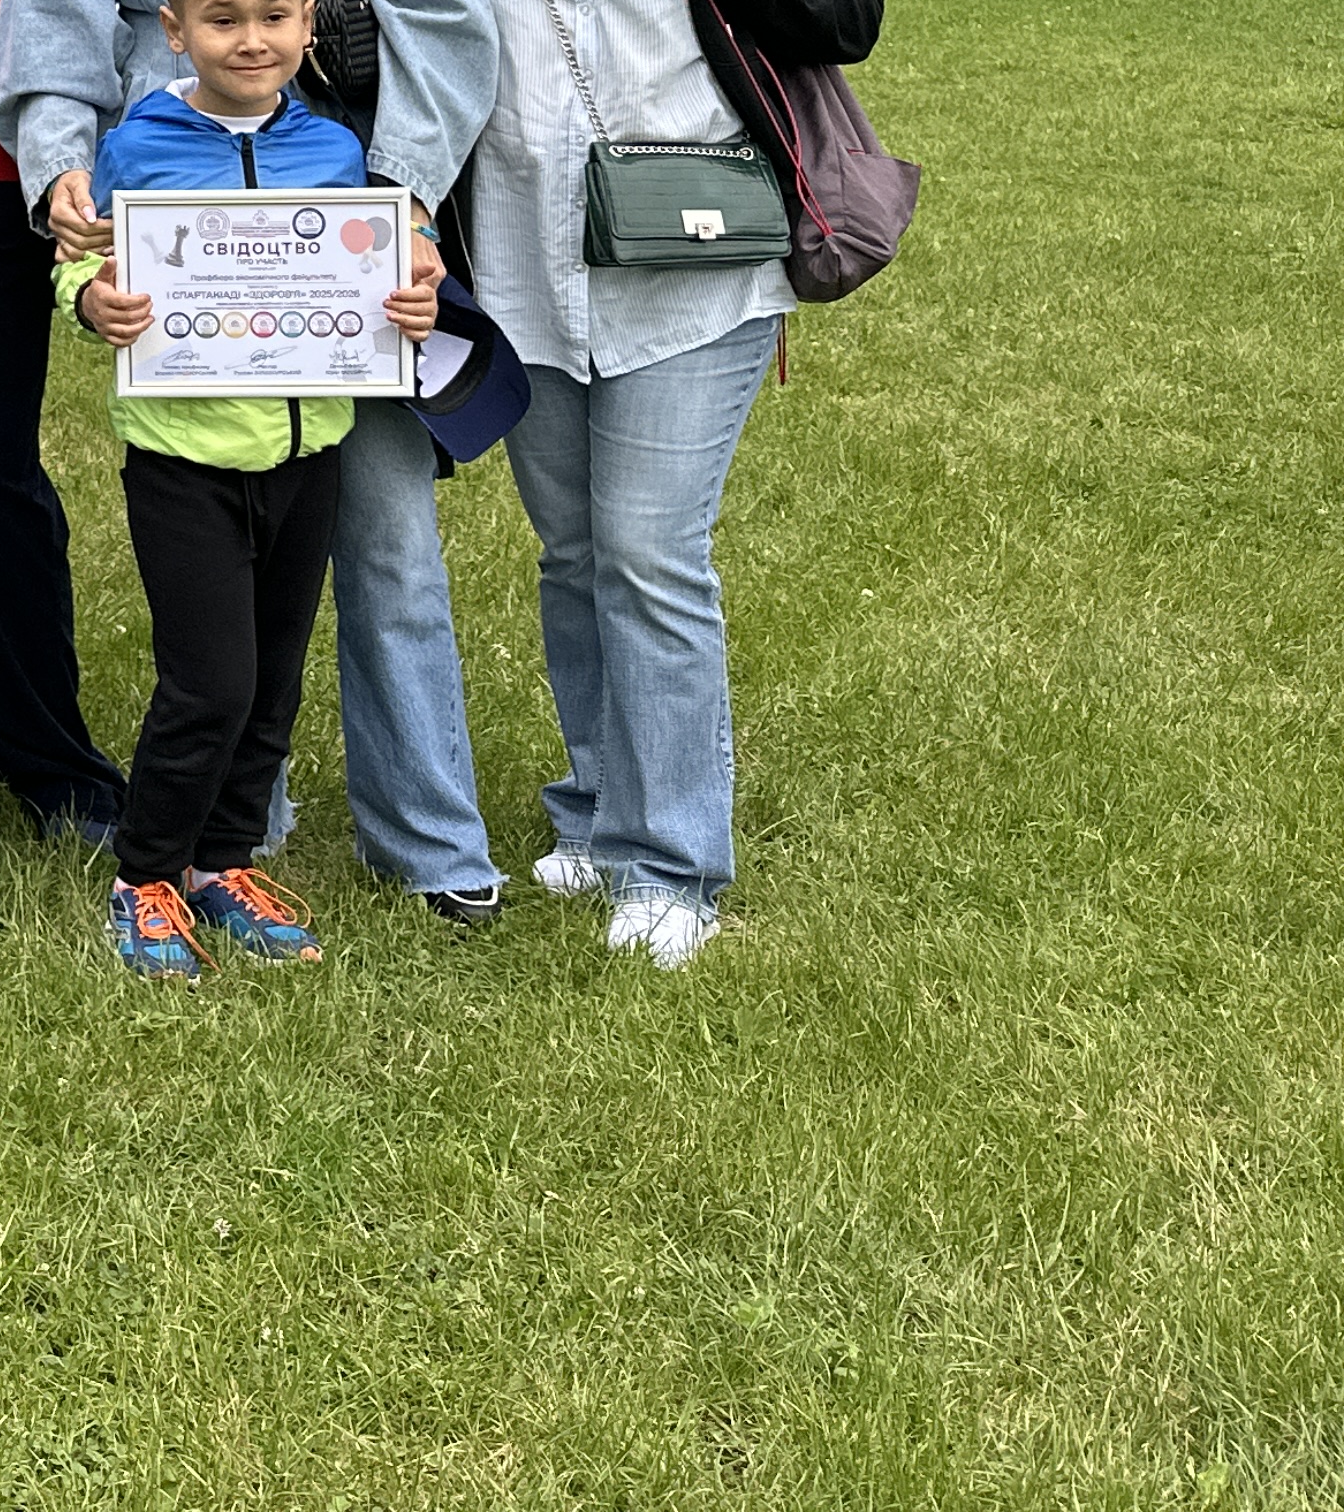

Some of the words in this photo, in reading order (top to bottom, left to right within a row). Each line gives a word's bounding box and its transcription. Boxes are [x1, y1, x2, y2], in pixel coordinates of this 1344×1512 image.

[203, 241, 322, 257] СВІДОЦТВО
[236, 258, 253, 266] ПРО
[255, 258, 288, 266] УЧАСТЬ
[172, 290, 241, 300] СПАРТАКІАДІ
